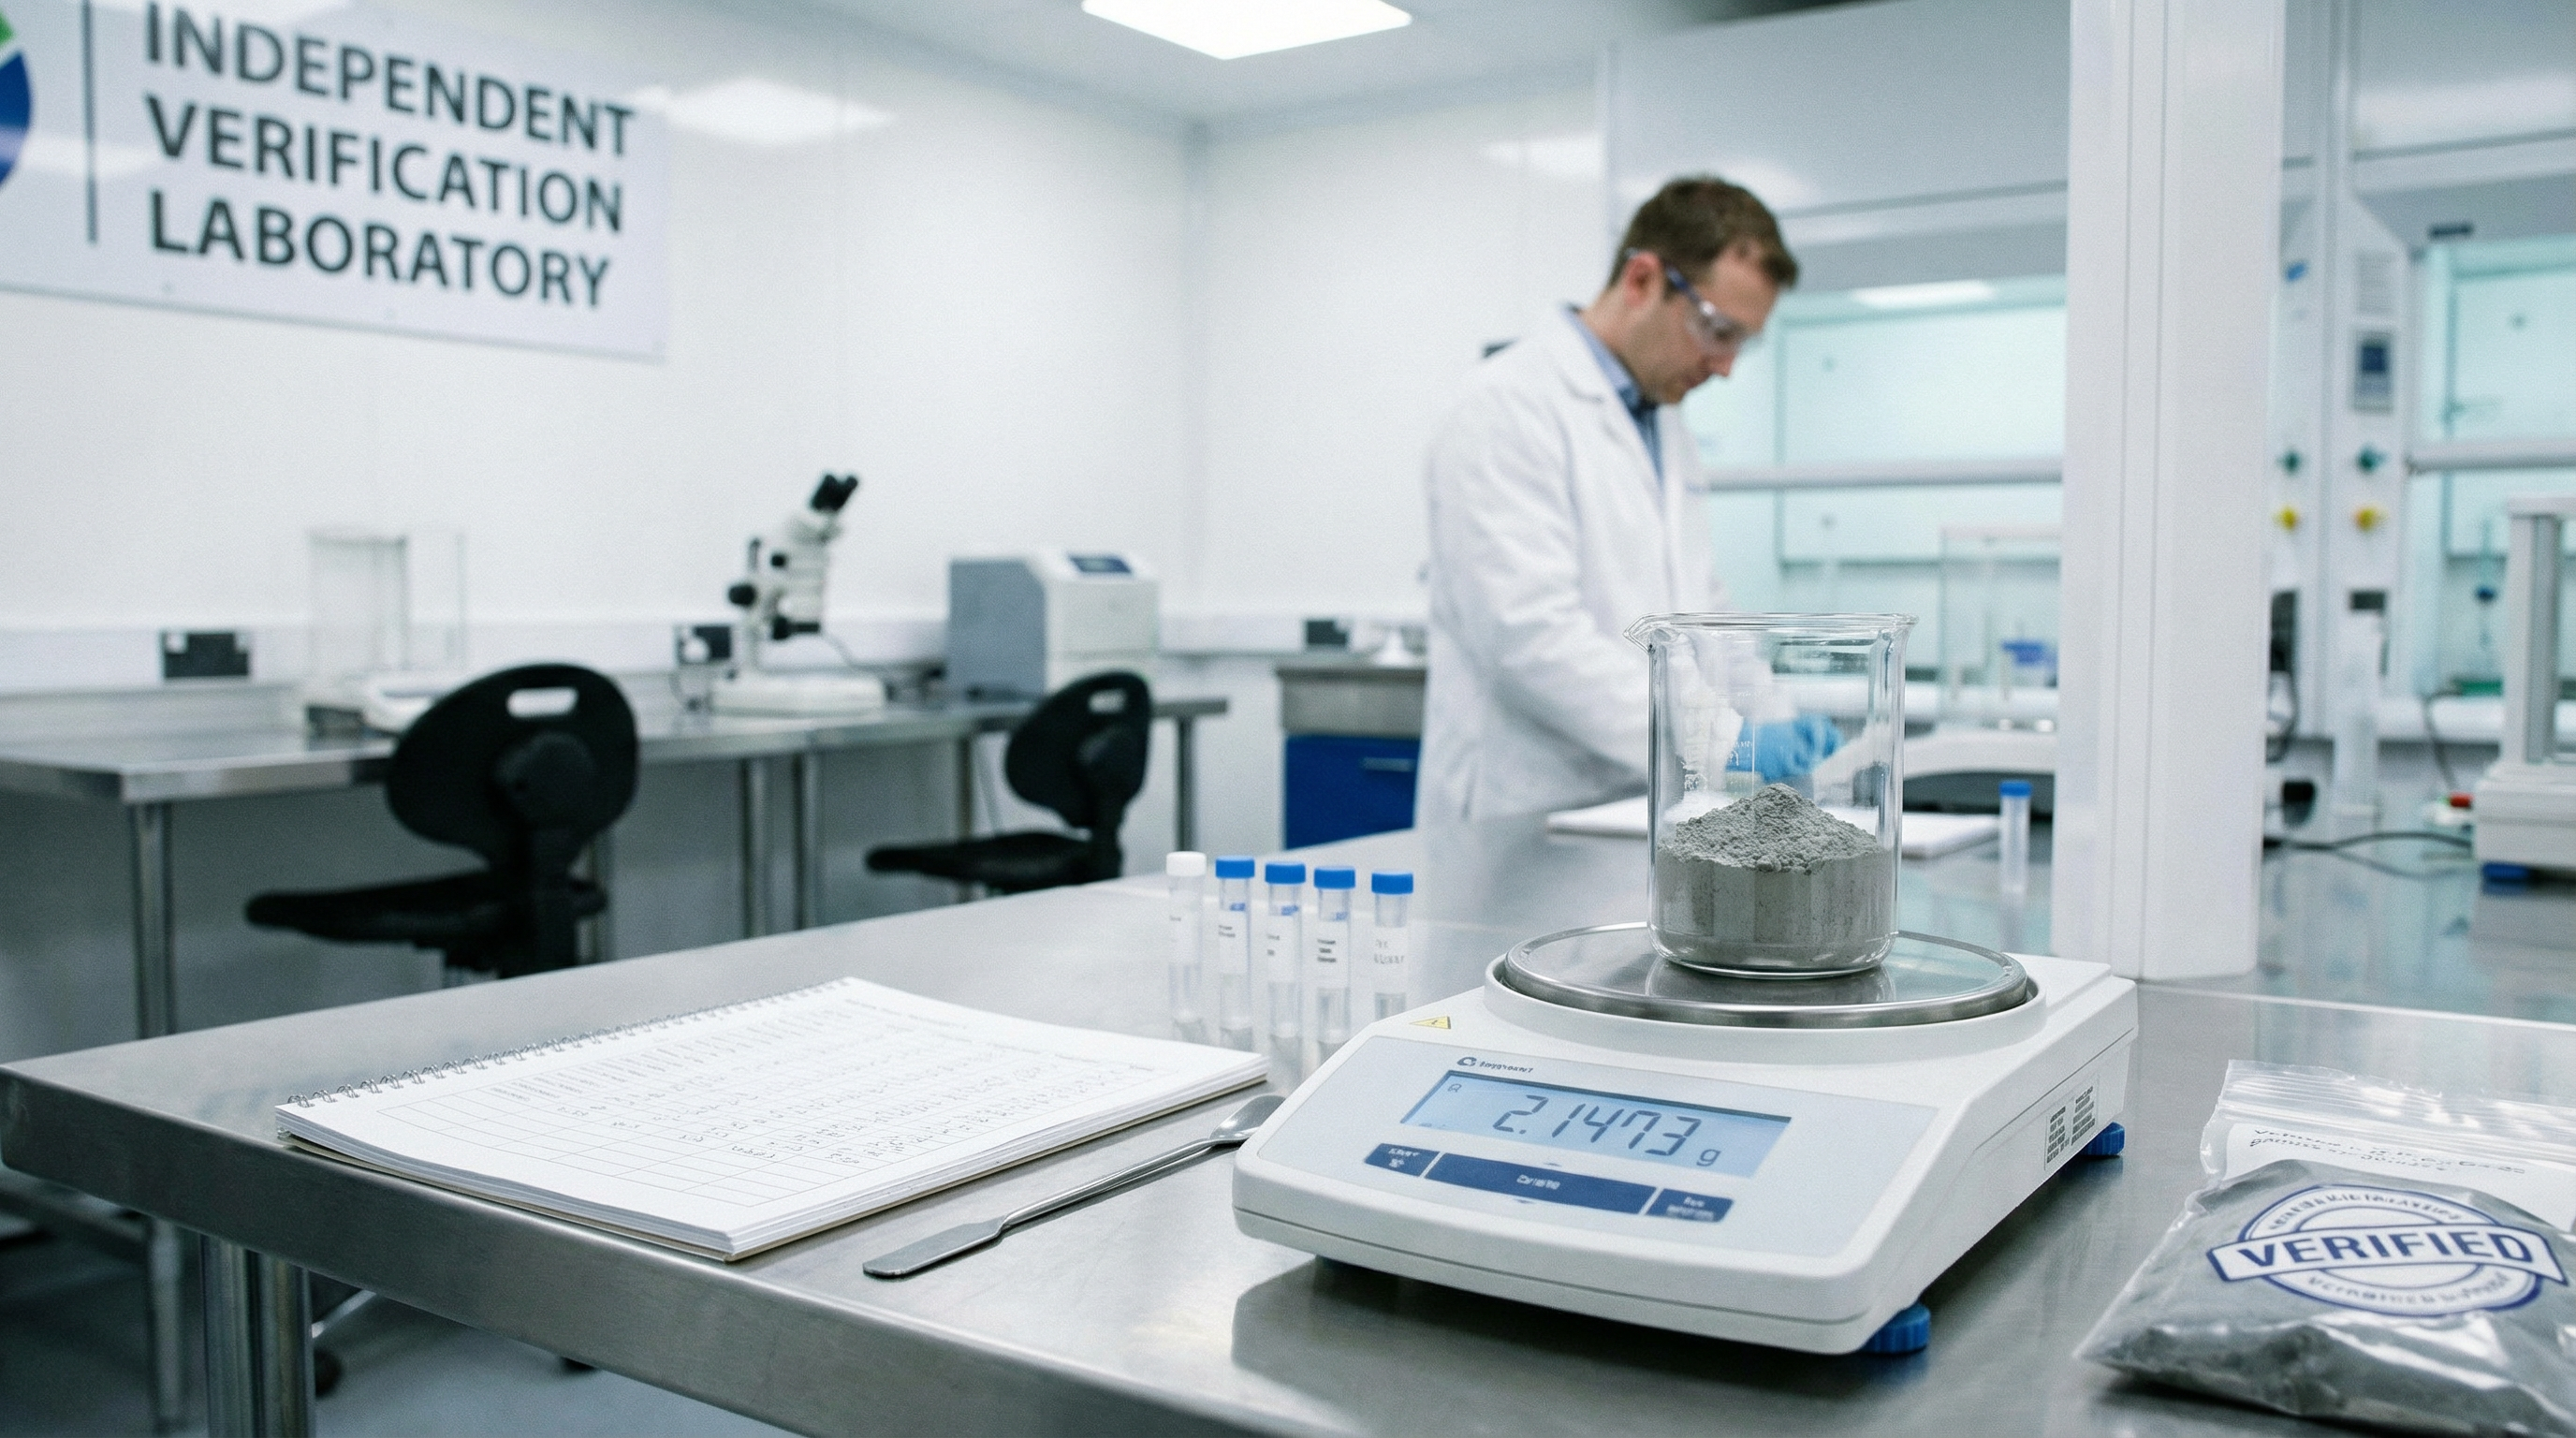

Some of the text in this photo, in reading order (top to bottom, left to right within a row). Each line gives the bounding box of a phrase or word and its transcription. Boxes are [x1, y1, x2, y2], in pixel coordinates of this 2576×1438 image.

[145, 2, 635, 156] INDEPENDENT
[144, 94, 623, 233] VERIFICATION
[151, 192, 610, 307] LABORATORY
[1493, 1094, 1721, 1167] 2.1473 g
[2238, 1231, 2533, 1267] VERIFIED
